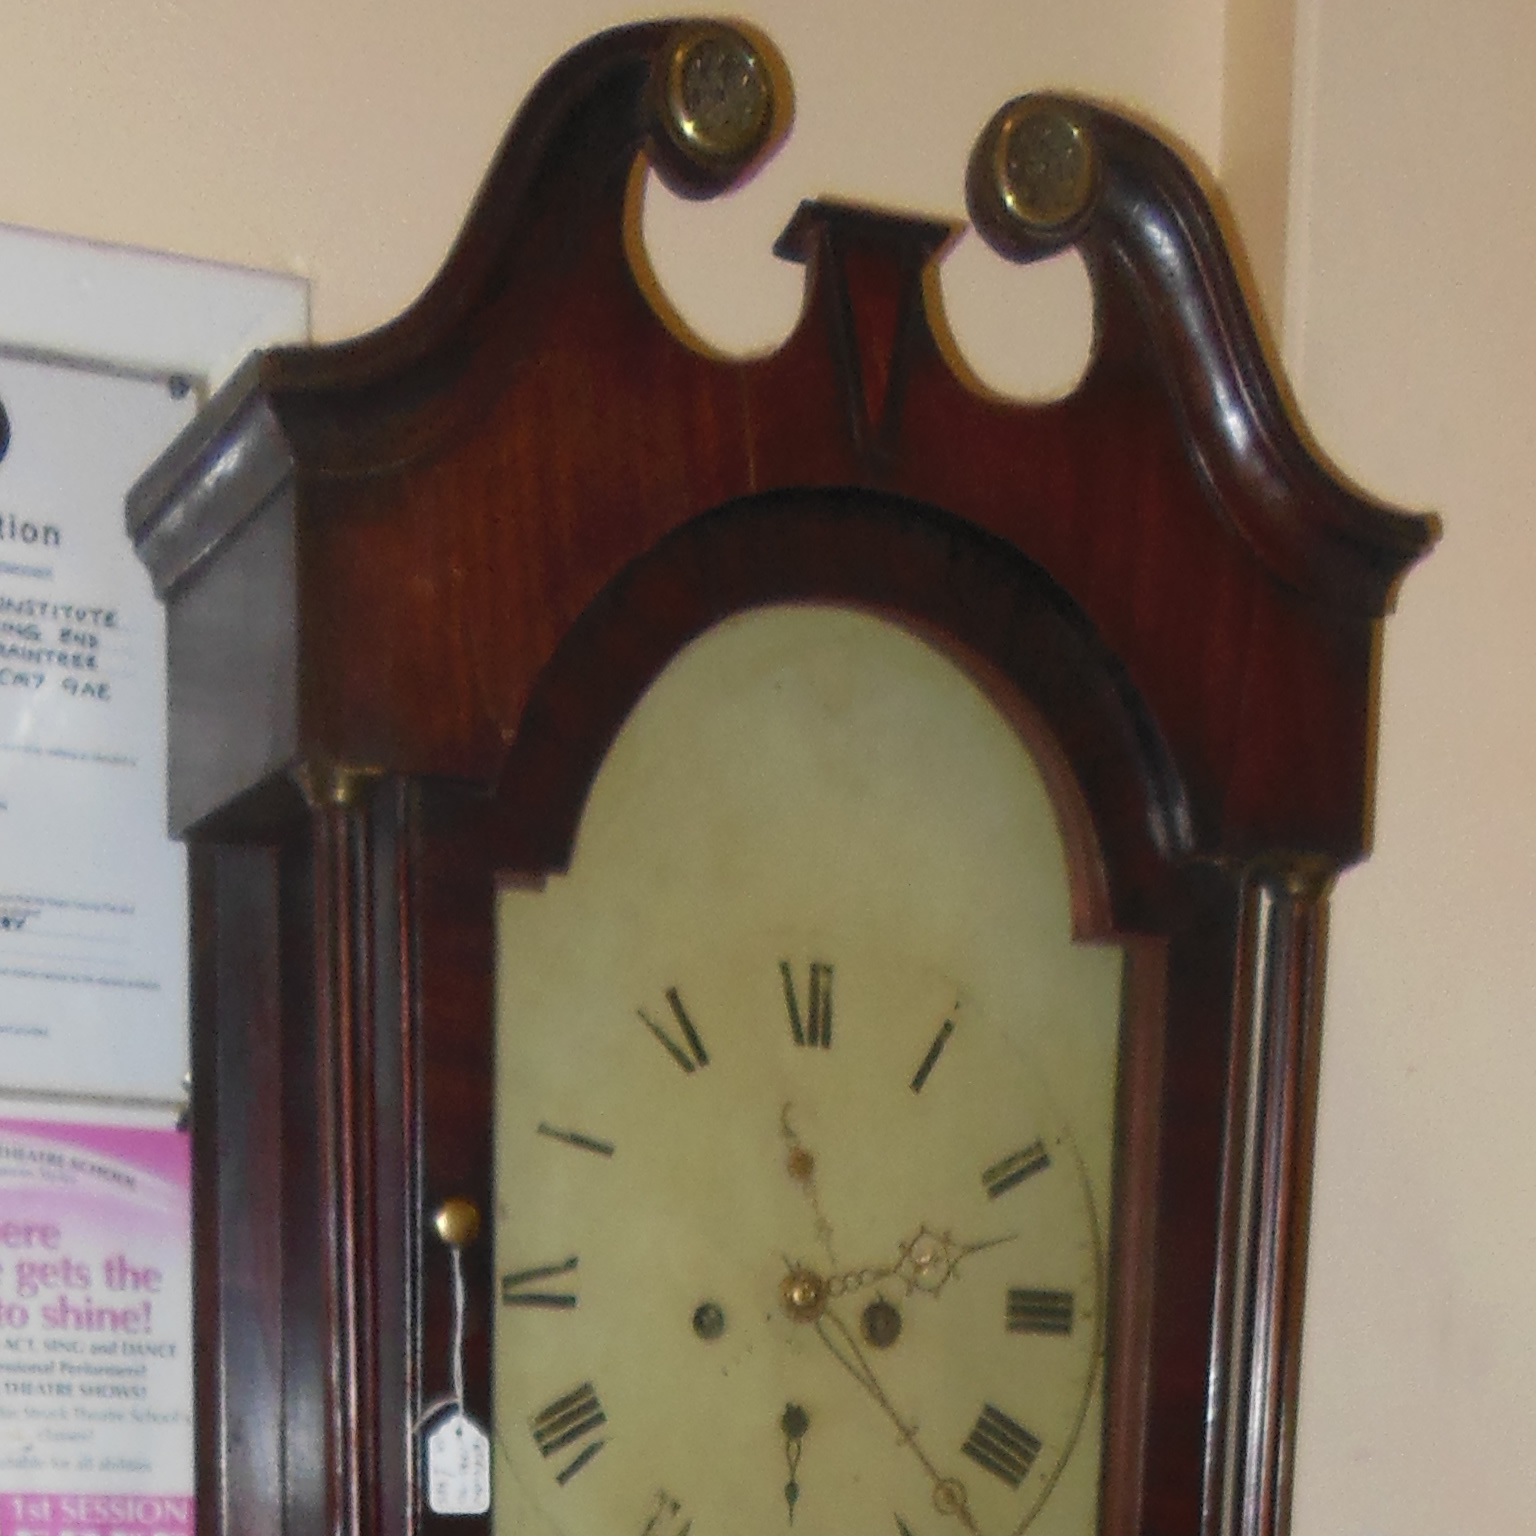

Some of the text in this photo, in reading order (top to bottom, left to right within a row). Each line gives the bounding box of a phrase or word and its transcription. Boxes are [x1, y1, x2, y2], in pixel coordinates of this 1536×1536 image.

[15, 1254, 162, 1297] gets the
[41, 1295, 152, 1333] shine!
[1005, 1287, 1074, 1336] III
[59, 1498, 190, 1525] SESSION
